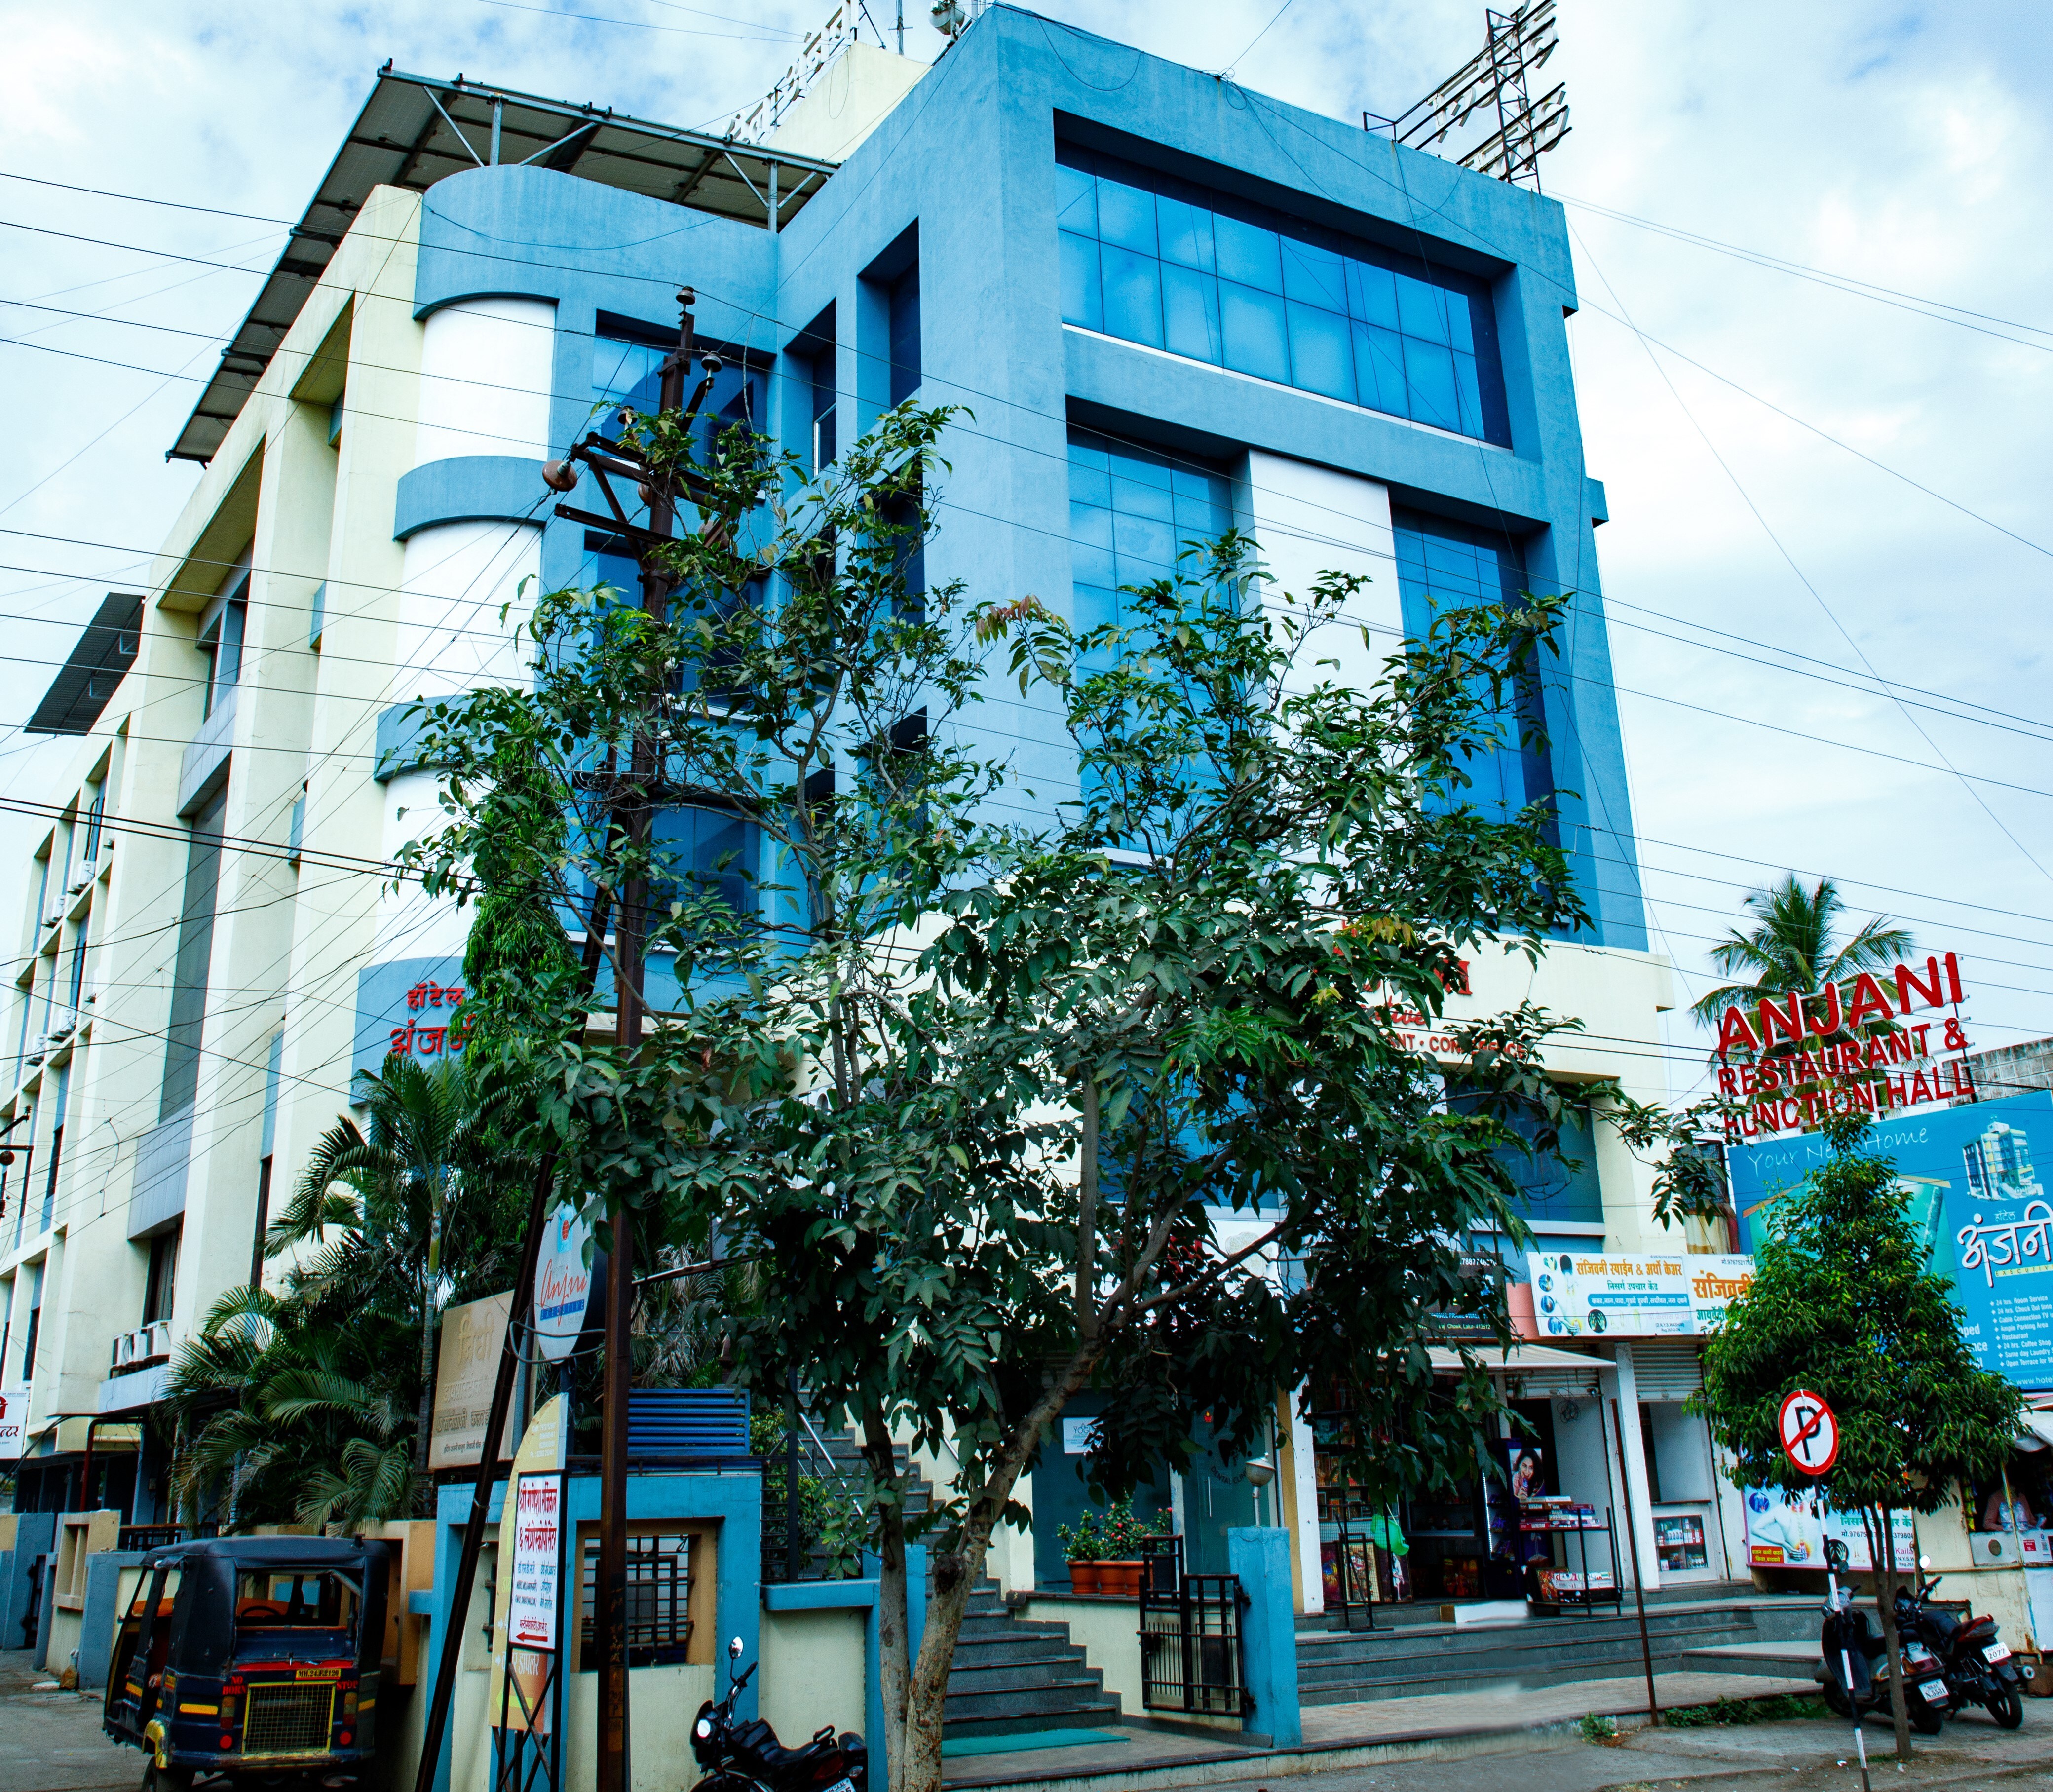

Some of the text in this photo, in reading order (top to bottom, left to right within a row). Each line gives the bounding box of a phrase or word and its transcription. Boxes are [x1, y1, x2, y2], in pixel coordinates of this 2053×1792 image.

[407, 980, 465, 1011] हॉटेल
[1718, 952, 1963, 1058] ANJANI
[1718, 1017, 1968, 1096] RESTAURANT &
[1886, 1062, 1975, 1109] HALL
[1747, 1127, 1929, 1178] Your Ne Home
[1636, 1264, 1644, 1275] &
[1995, 1265, 2053, 1277] EXECUTIV
[2002, 1332, 2028, 1340] Restaurant
[1211, 1465, 1247, 1485] DENTAL CLIN
[1988, 1648, 2006, 1660] 2077
[222, 1685, 246, 1695] HORN
[336, 1680, 359, 1690] STOP
